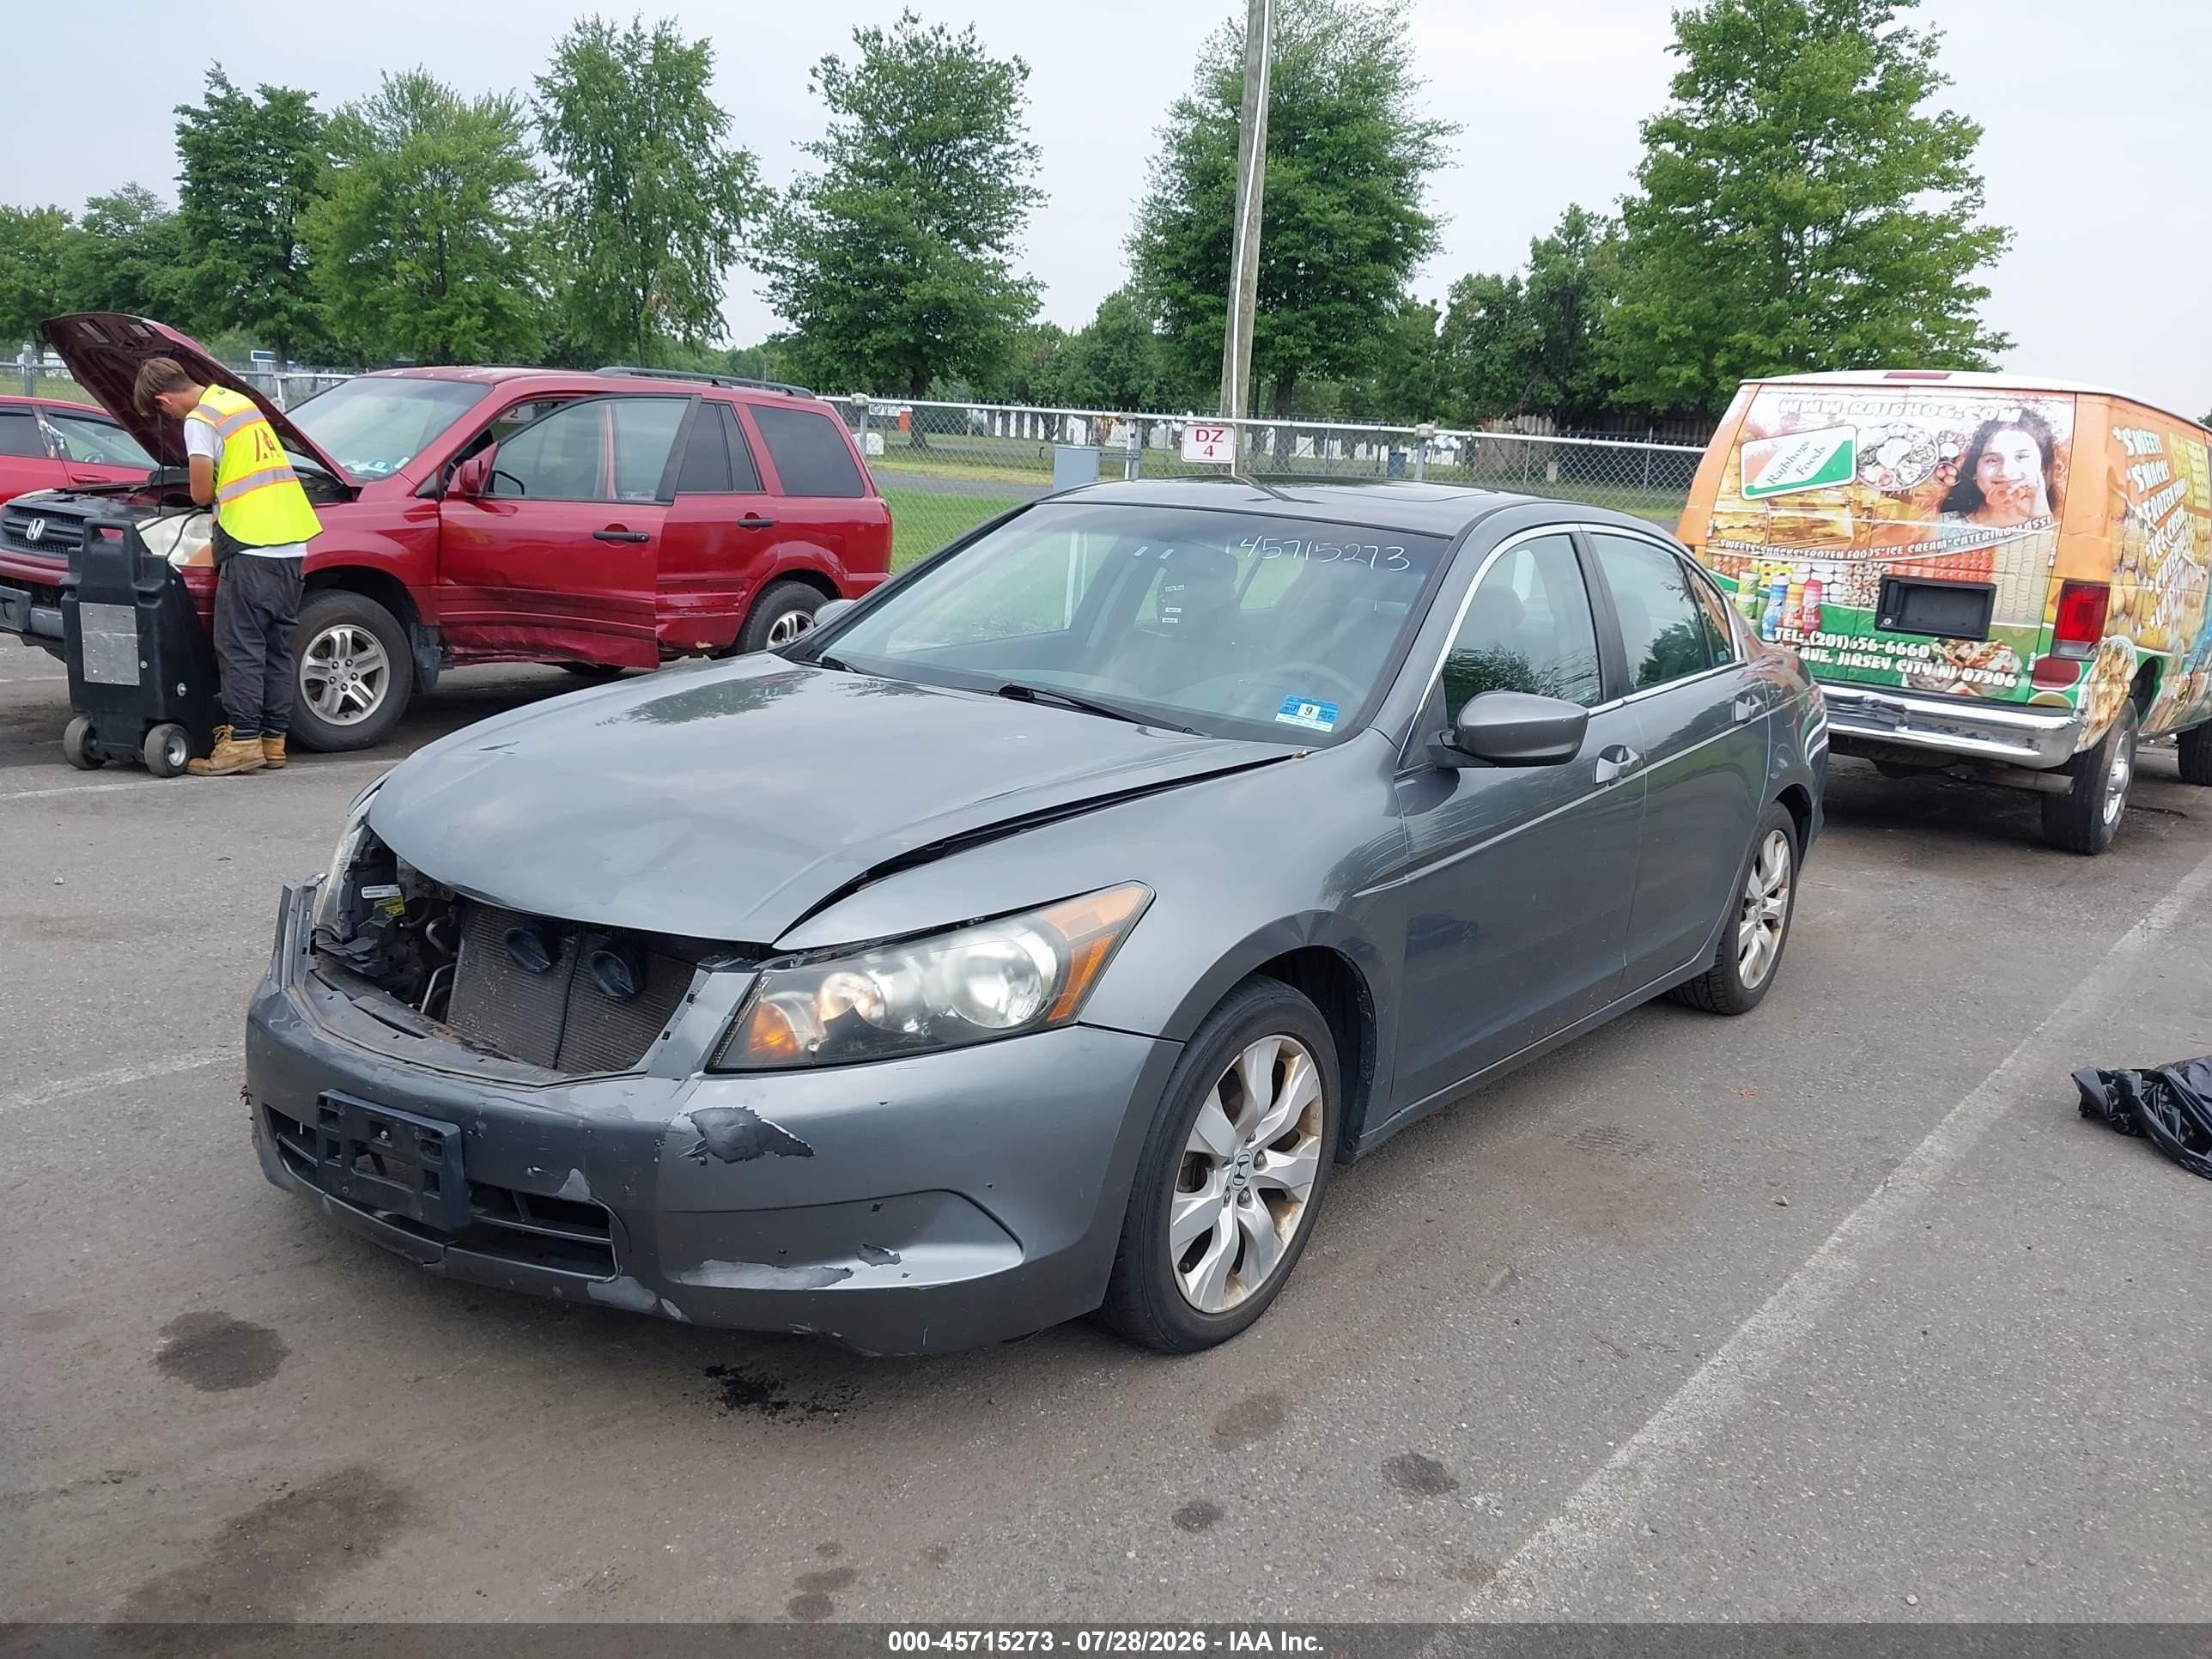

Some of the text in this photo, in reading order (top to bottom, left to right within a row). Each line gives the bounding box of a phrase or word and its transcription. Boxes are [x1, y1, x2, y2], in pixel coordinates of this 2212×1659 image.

[1778, 399, 2022, 422] WWW.RAJBHOG.COM
[1195, 428, 1224, 443] DZ
[1203, 445, 1215, 458] 4
[1796, 447, 1826, 476] Foods
[1240, 535, 1411, 571] 45715273
[1847, 548, 1881, 559] FOODS
[1886, 545, 1904, 555] ICE
[1907, 540, 1947, 554] CREAM
[1774, 627, 1804, 643] TEL:
[1809, 631, 1930, 660] (201)656-6660
[1895, 659, 1934, 676] CITY
[1938, 663, 1958, 680] NJ
[1961, 668, 2017, 688] 07306
[1304, 706, 1314, 716] 9
